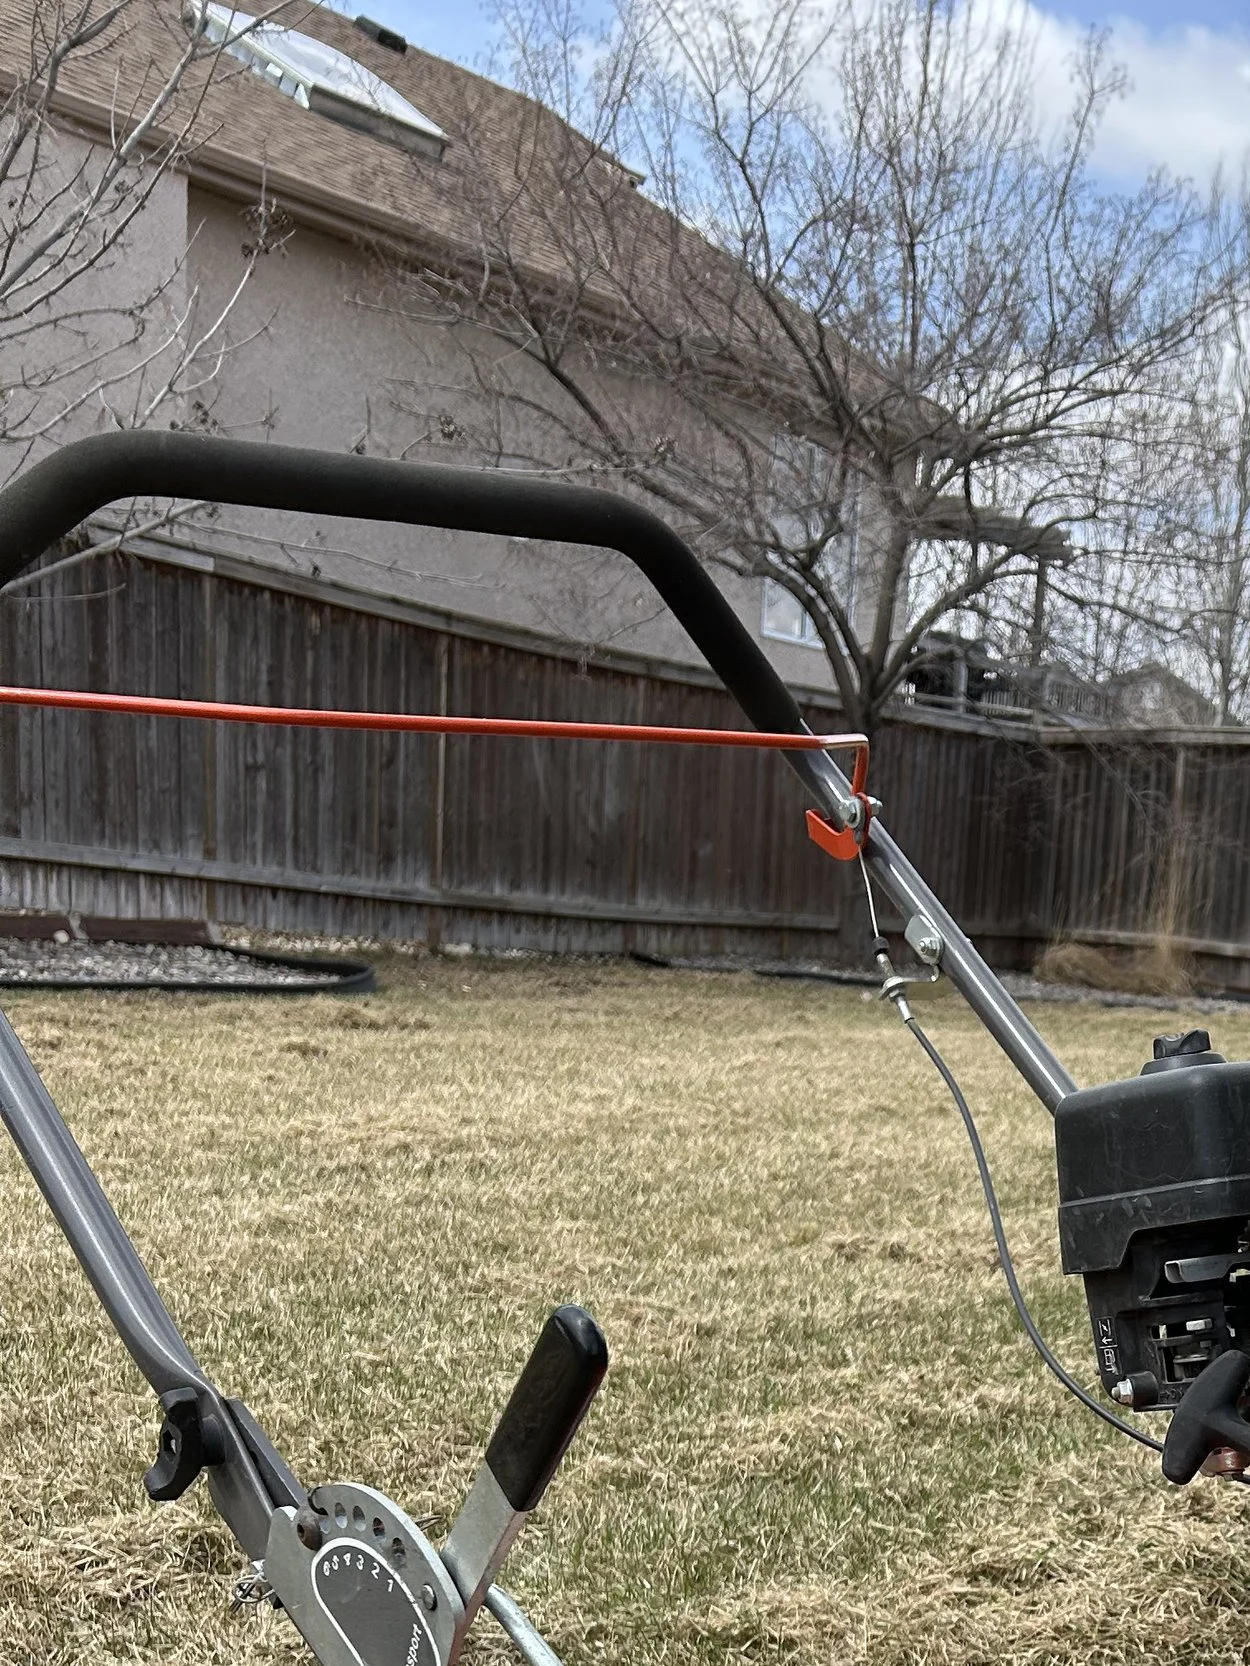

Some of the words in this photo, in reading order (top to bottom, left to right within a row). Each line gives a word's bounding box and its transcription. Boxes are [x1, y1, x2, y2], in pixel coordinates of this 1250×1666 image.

[322, 1561, 331, 1576] 6
[331, 1554, 340, 1571] 5
[343, 1552, 351, 1566] 4
[356, 1554, 365, 1570] 3
[370, 1561, 380, 1579] 2
[387, 1579, 394, 1593] 1
